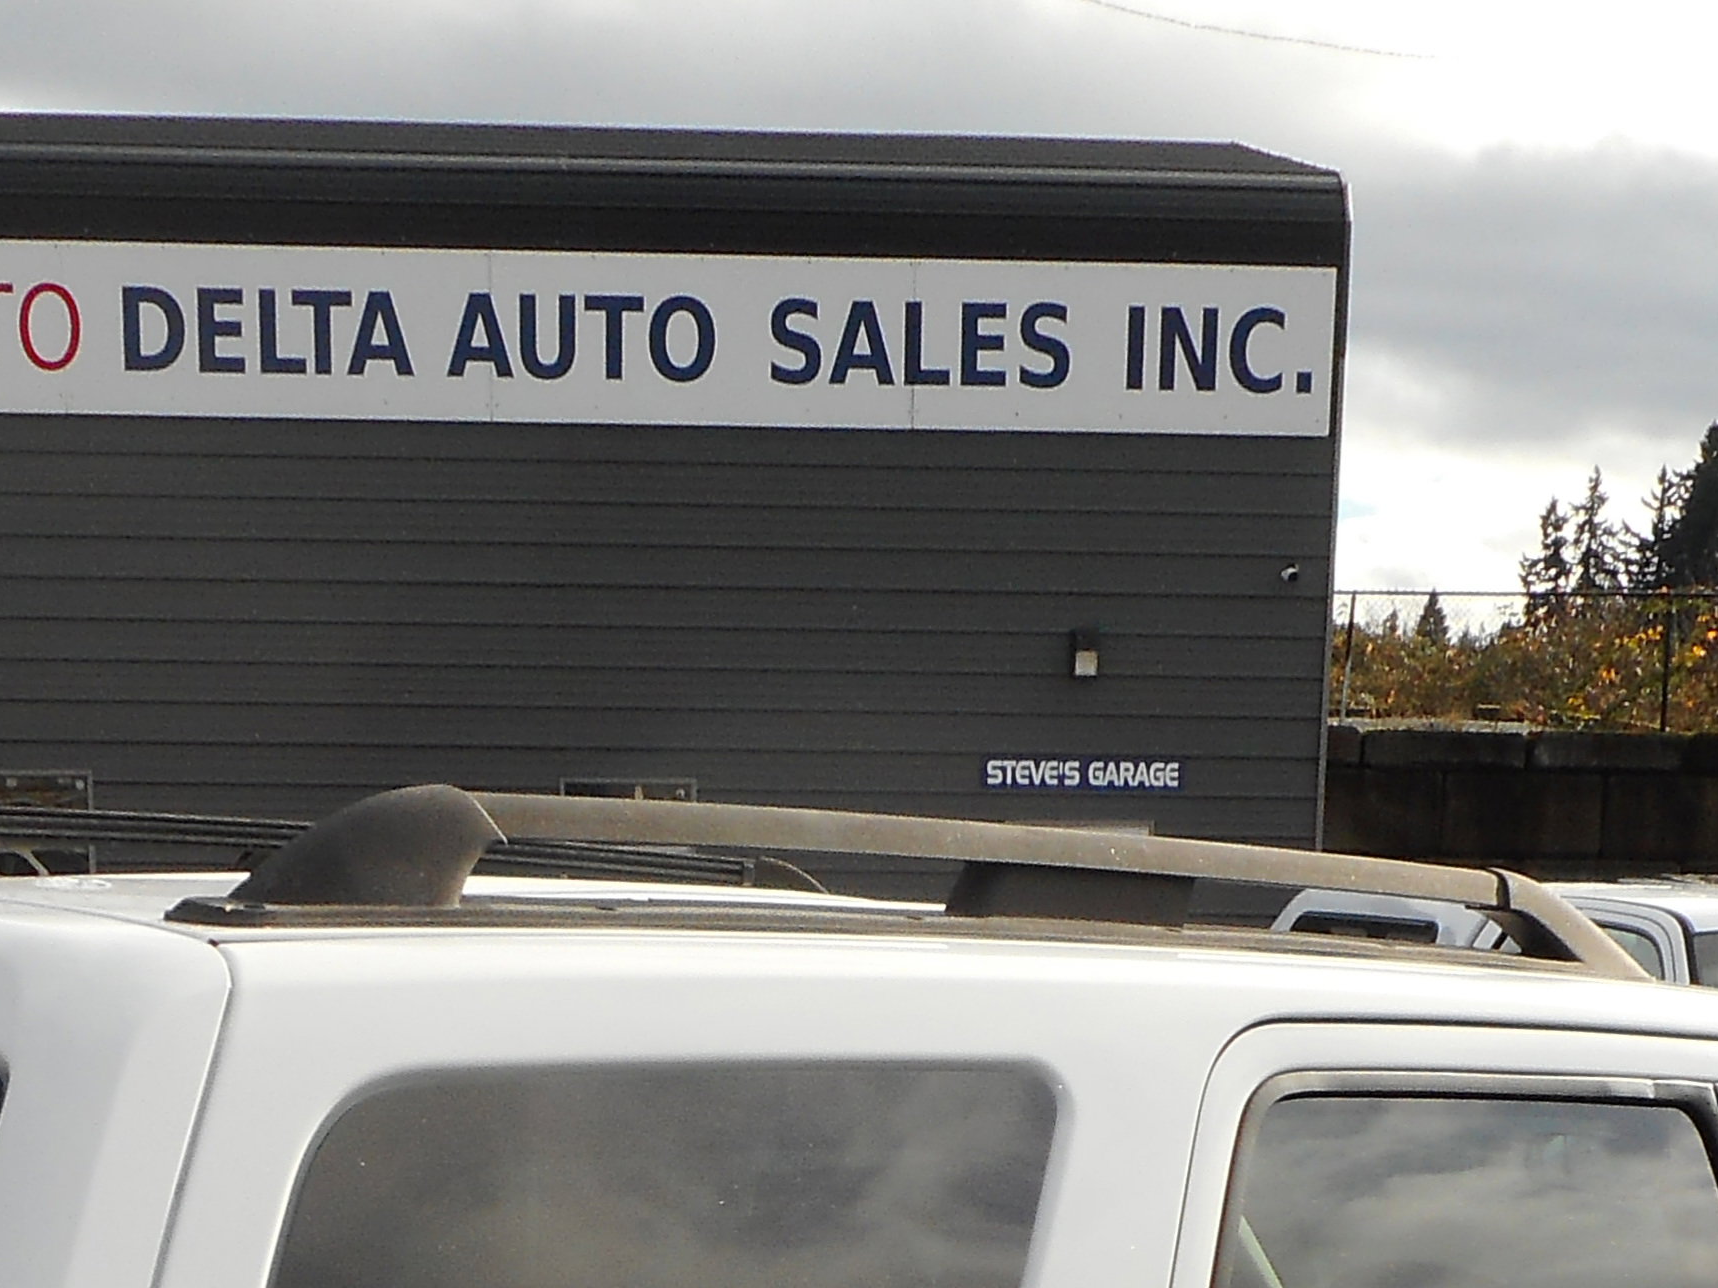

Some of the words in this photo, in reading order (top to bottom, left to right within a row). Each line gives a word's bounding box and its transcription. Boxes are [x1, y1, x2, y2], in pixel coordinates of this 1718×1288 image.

[120, 284, 415, 377] DELTA
[446, 292, 717, 383] AUTO
[769, 298, 1072, 390] SALES
[1124, 305, 1314, 395] INC.
[986, 759, 1081, 786] STEVE'S
[1087, 761, 1180, 788] GARAGE
